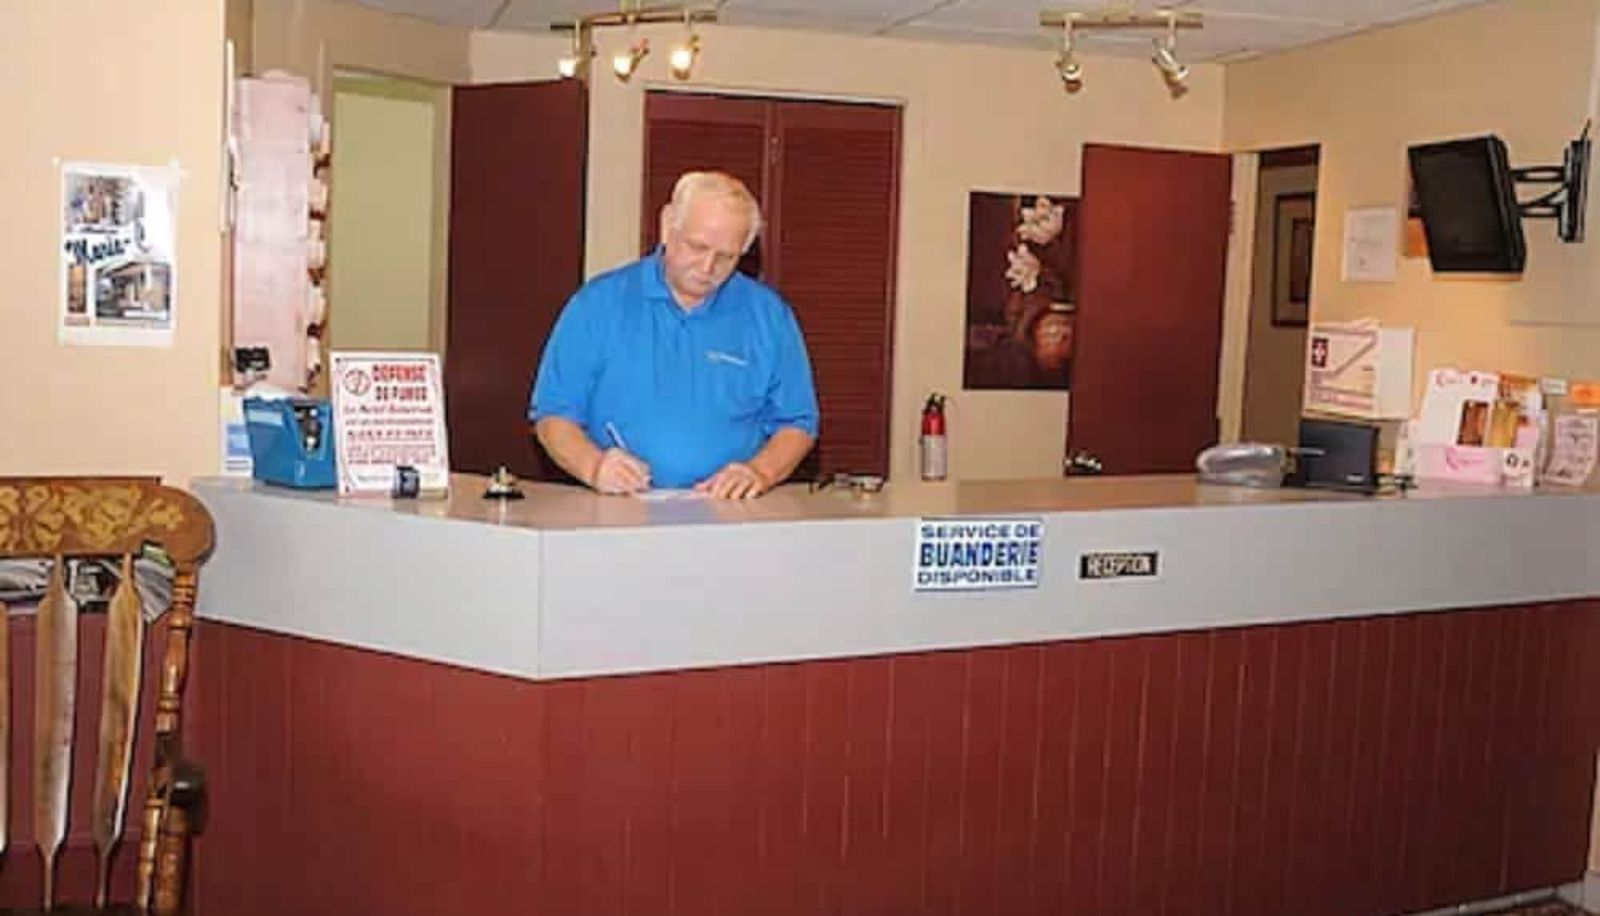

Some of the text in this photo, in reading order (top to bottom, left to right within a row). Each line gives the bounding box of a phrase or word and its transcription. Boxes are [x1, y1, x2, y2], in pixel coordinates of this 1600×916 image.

[920, 523, 1041, 539] SERVICE DE
[920, 541, 1040, 567] BUANDERIE
[917, 569, 1035, 585] DISPONIBLE
